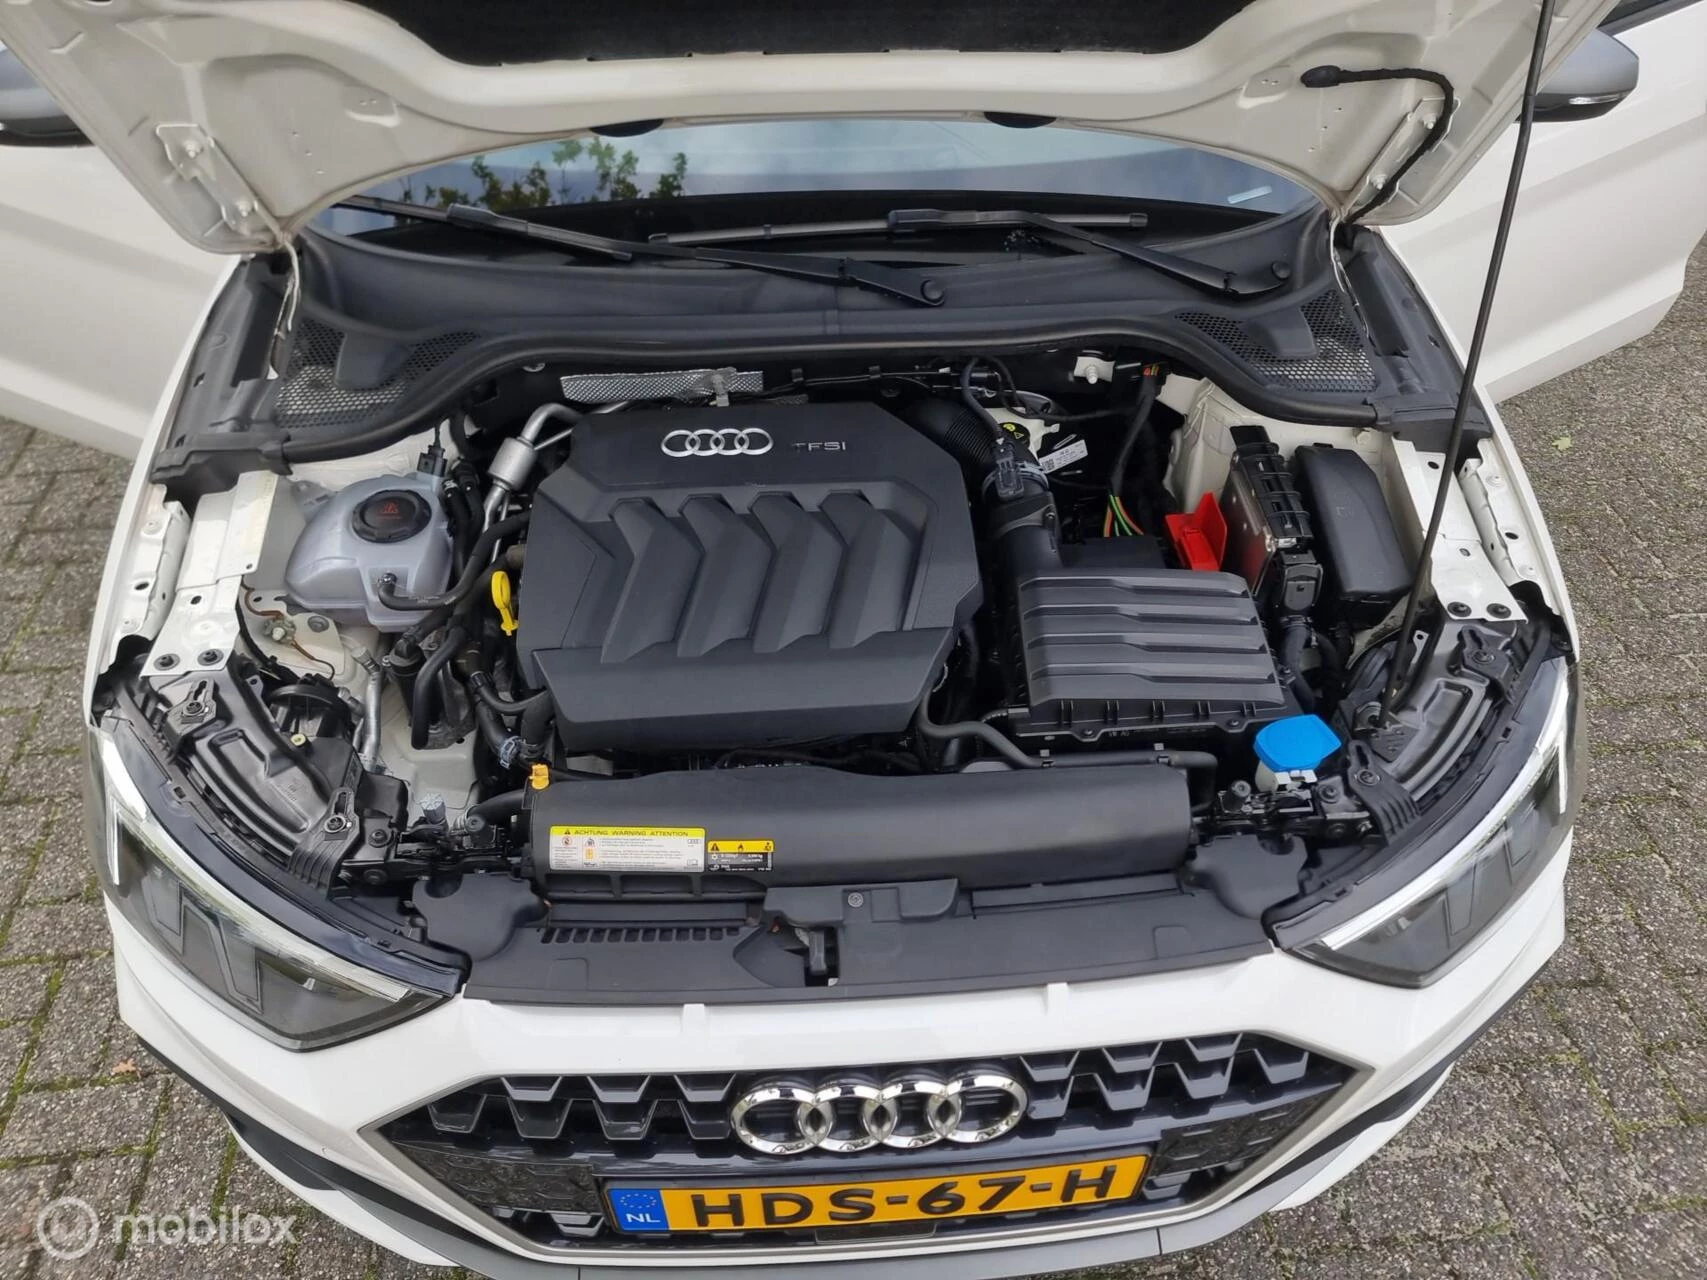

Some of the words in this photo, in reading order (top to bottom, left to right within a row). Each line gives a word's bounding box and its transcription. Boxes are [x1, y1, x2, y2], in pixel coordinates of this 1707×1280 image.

[792, 441, 847, 451] TFSI
[692, 1165, 1117, 1228] HDS-67-H
[626, 1212, 660, 1224] NL
